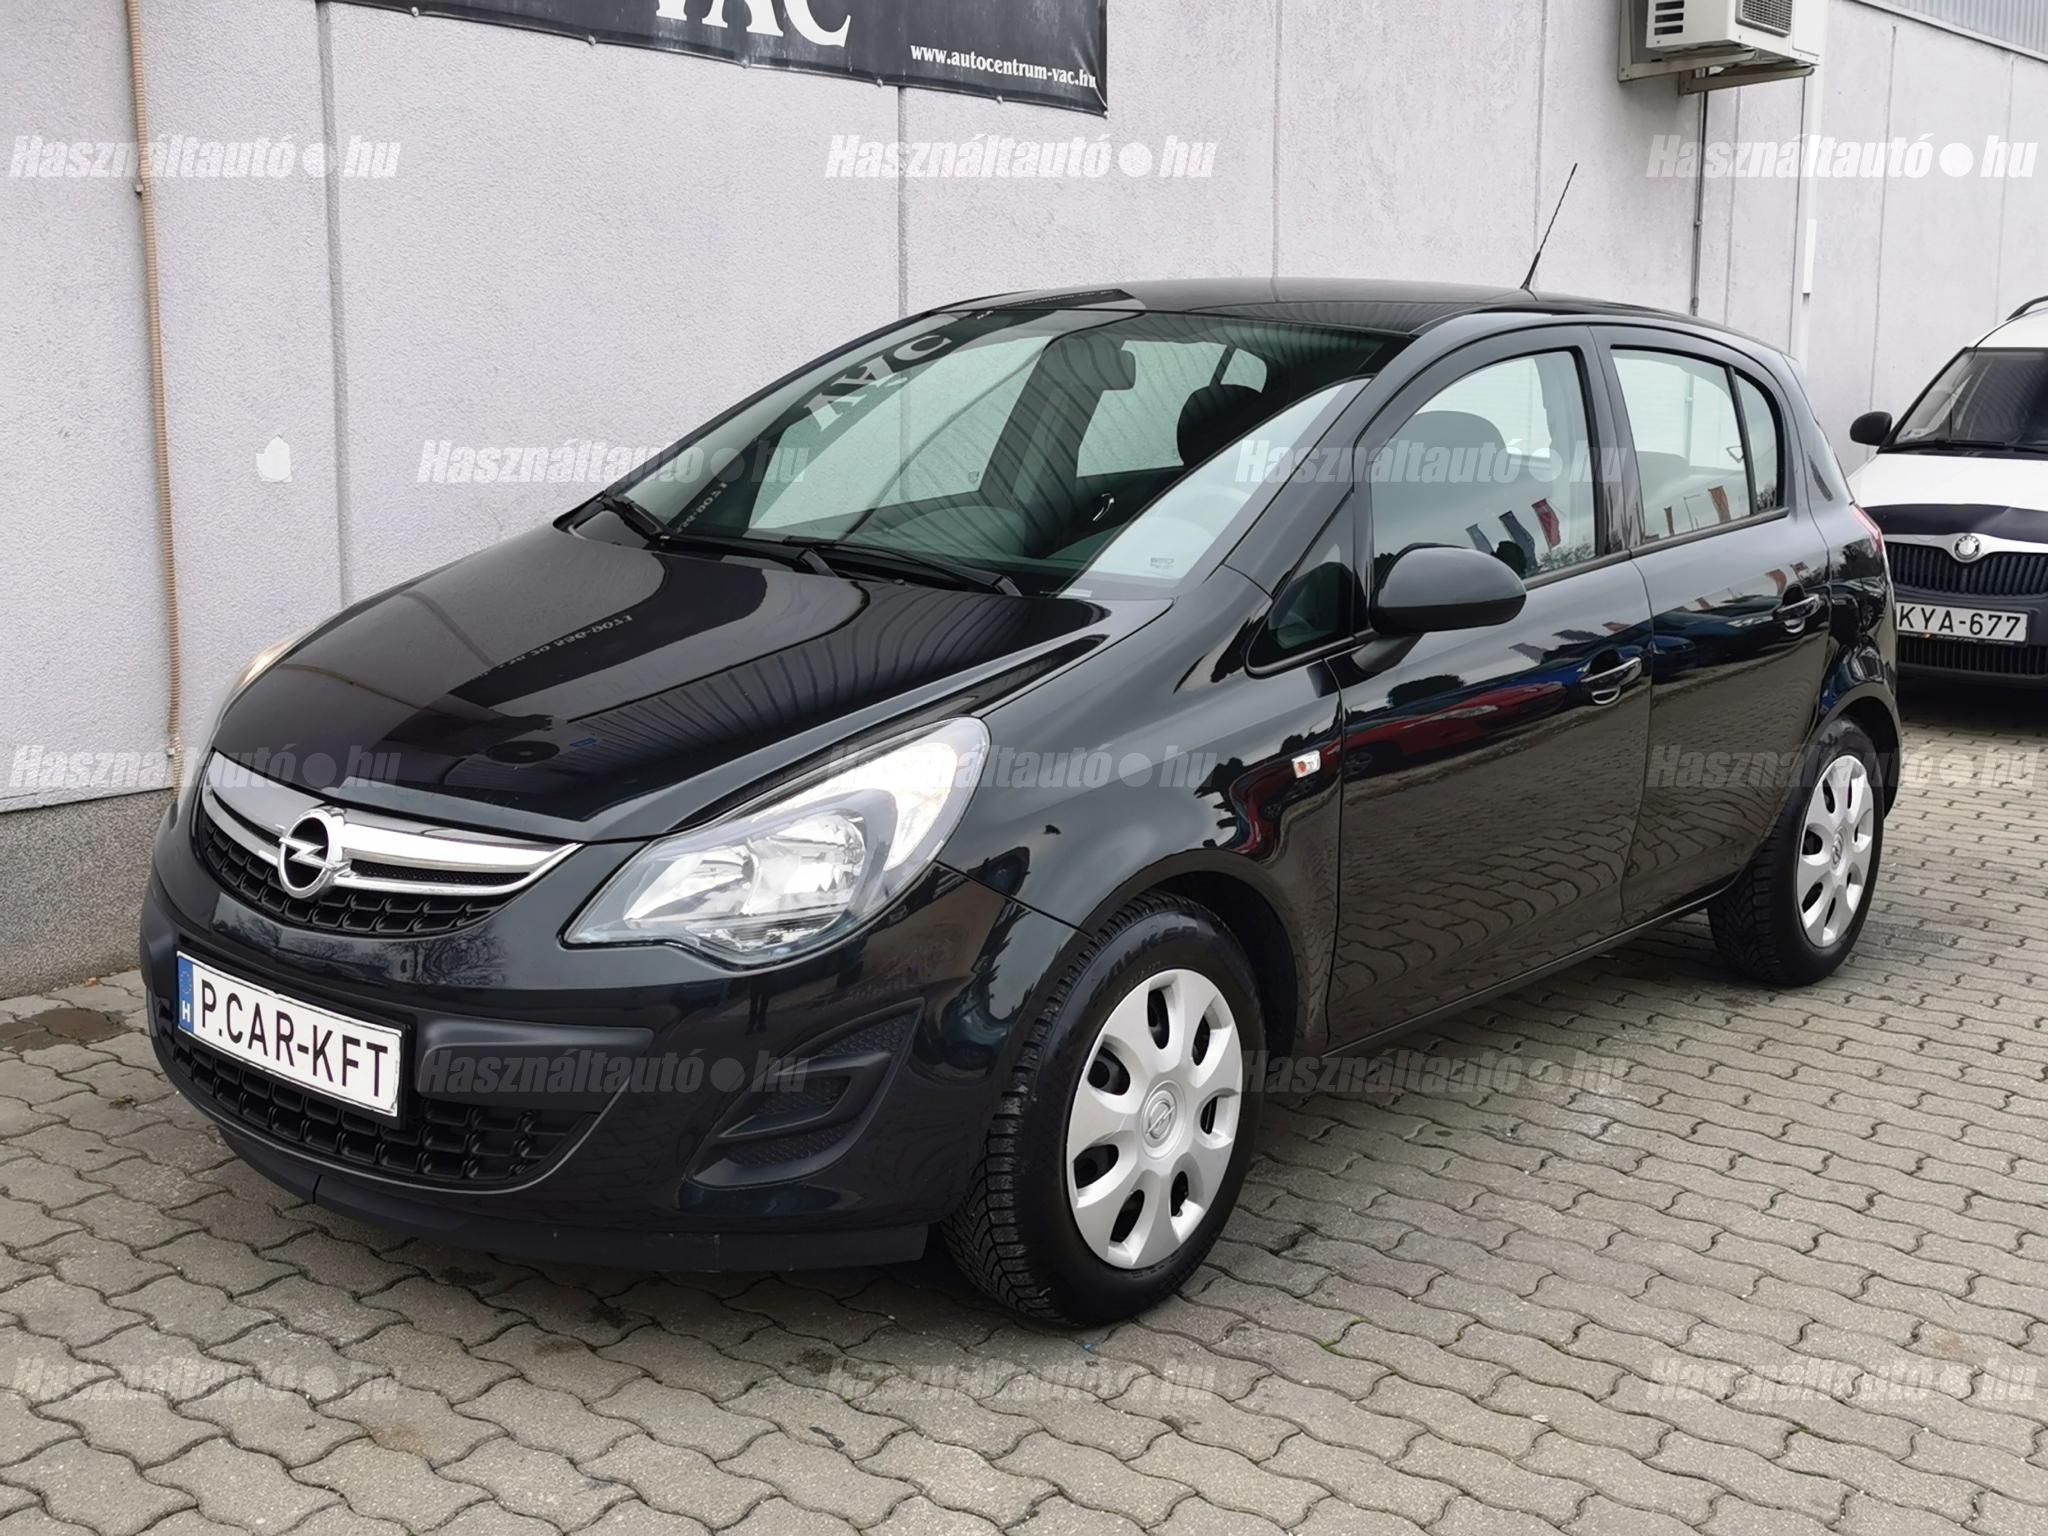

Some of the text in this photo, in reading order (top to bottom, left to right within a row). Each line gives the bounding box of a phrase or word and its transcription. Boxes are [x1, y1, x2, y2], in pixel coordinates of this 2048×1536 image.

[910, 45, 1097, 88] www.autocentrum-vac.hu
[1899, 605, 2021, 638] KYA-677
[181, 1000, 191, 1023] H
[201, 979, 388, 1098] P.CAR-KFT
